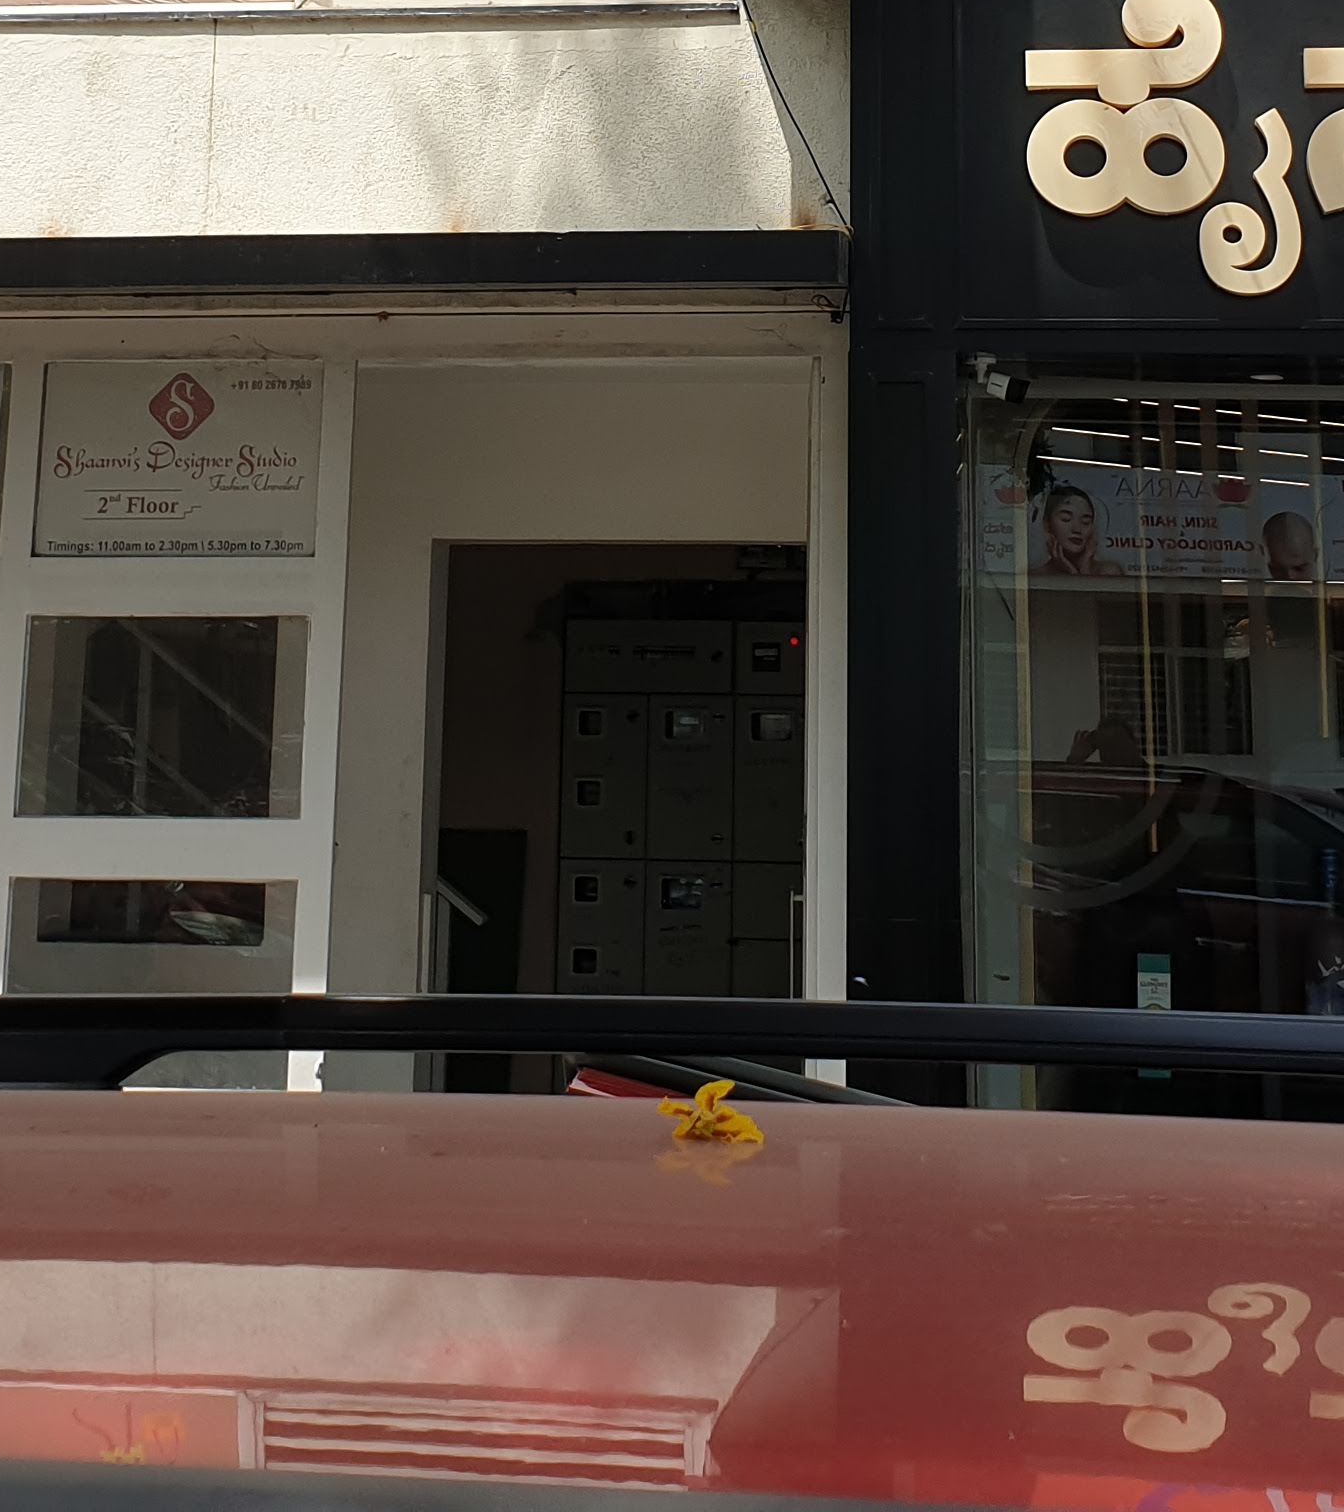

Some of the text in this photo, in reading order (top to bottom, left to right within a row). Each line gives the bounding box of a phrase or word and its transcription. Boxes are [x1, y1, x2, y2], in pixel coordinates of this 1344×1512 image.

[147, 440, 234, 480] Designer
[236, 443, 297, 478] Studio
[125, 496, 179, 514] Floor
[47, 541, 94, 553] Timings:
[97, 541, 142, 552] 11.00am
[144, 541, 156, 551] to
[158, 541, 199, 554] 2.30pm
[207, 541, 248, 554] 5.30pm
[250, 541, 262, 551] to
[264, 541, 304, 554] 7.30pm
